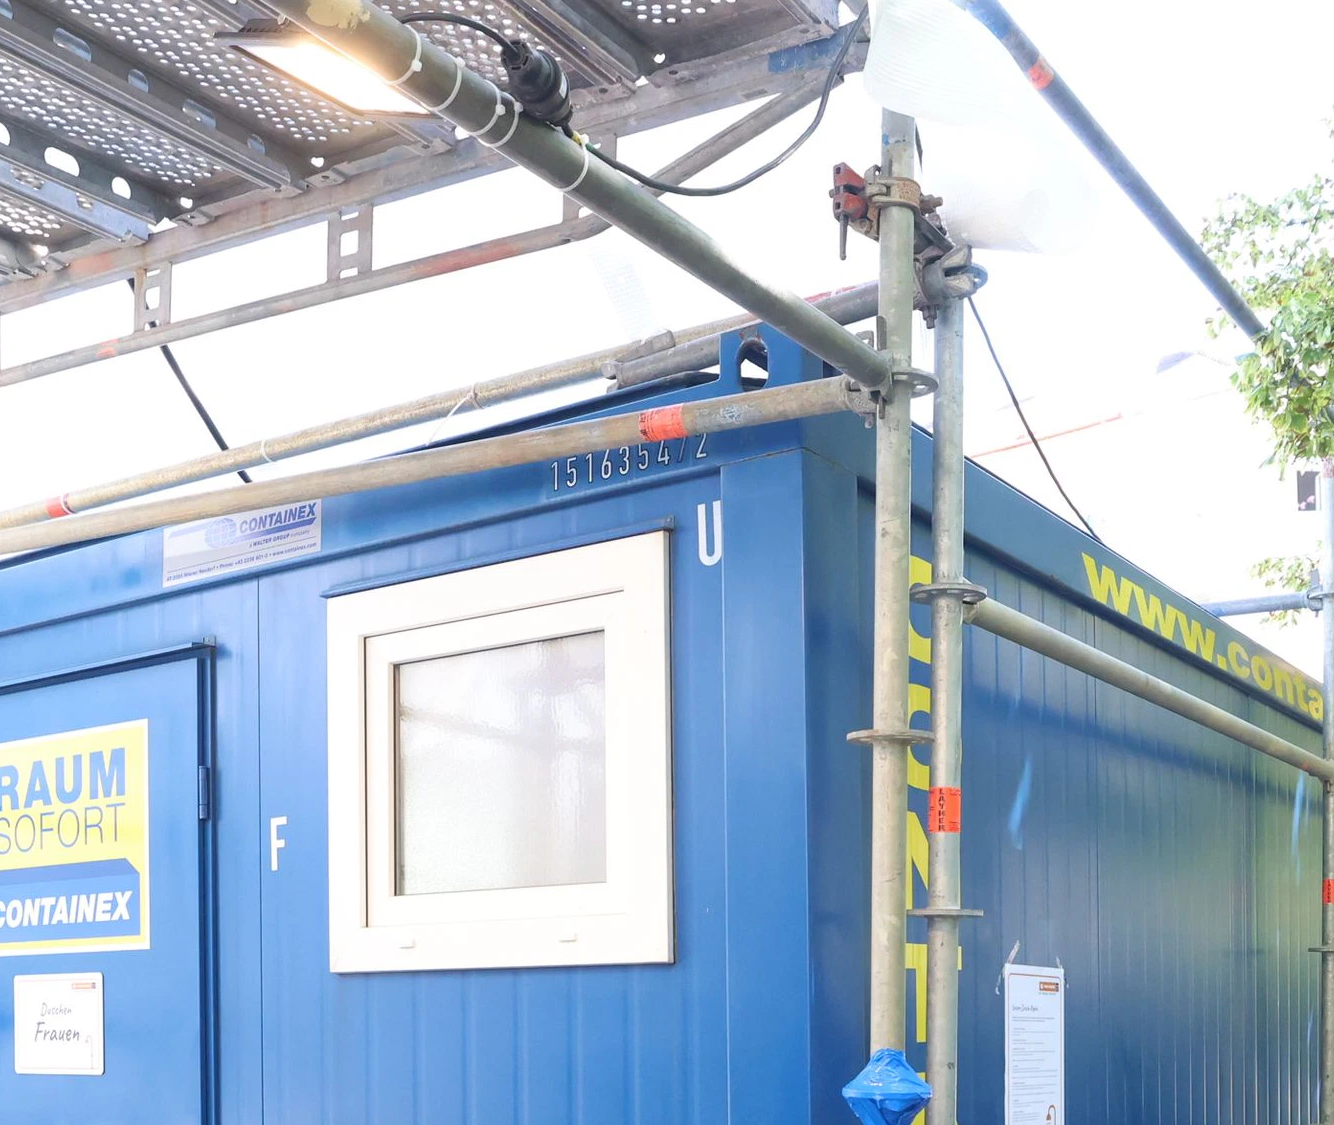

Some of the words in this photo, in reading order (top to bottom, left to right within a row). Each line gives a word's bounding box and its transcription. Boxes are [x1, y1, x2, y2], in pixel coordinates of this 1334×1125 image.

[239, 502, 317, 534] CONTAINEX
[273, 533, 290, 542] GROUP
[697, 500, 722, 567] U
[270, 816, 288, 871] F
[40, 1002, 72, 1017] Duschen
[34, 1021, 81, 1042] Frauen
